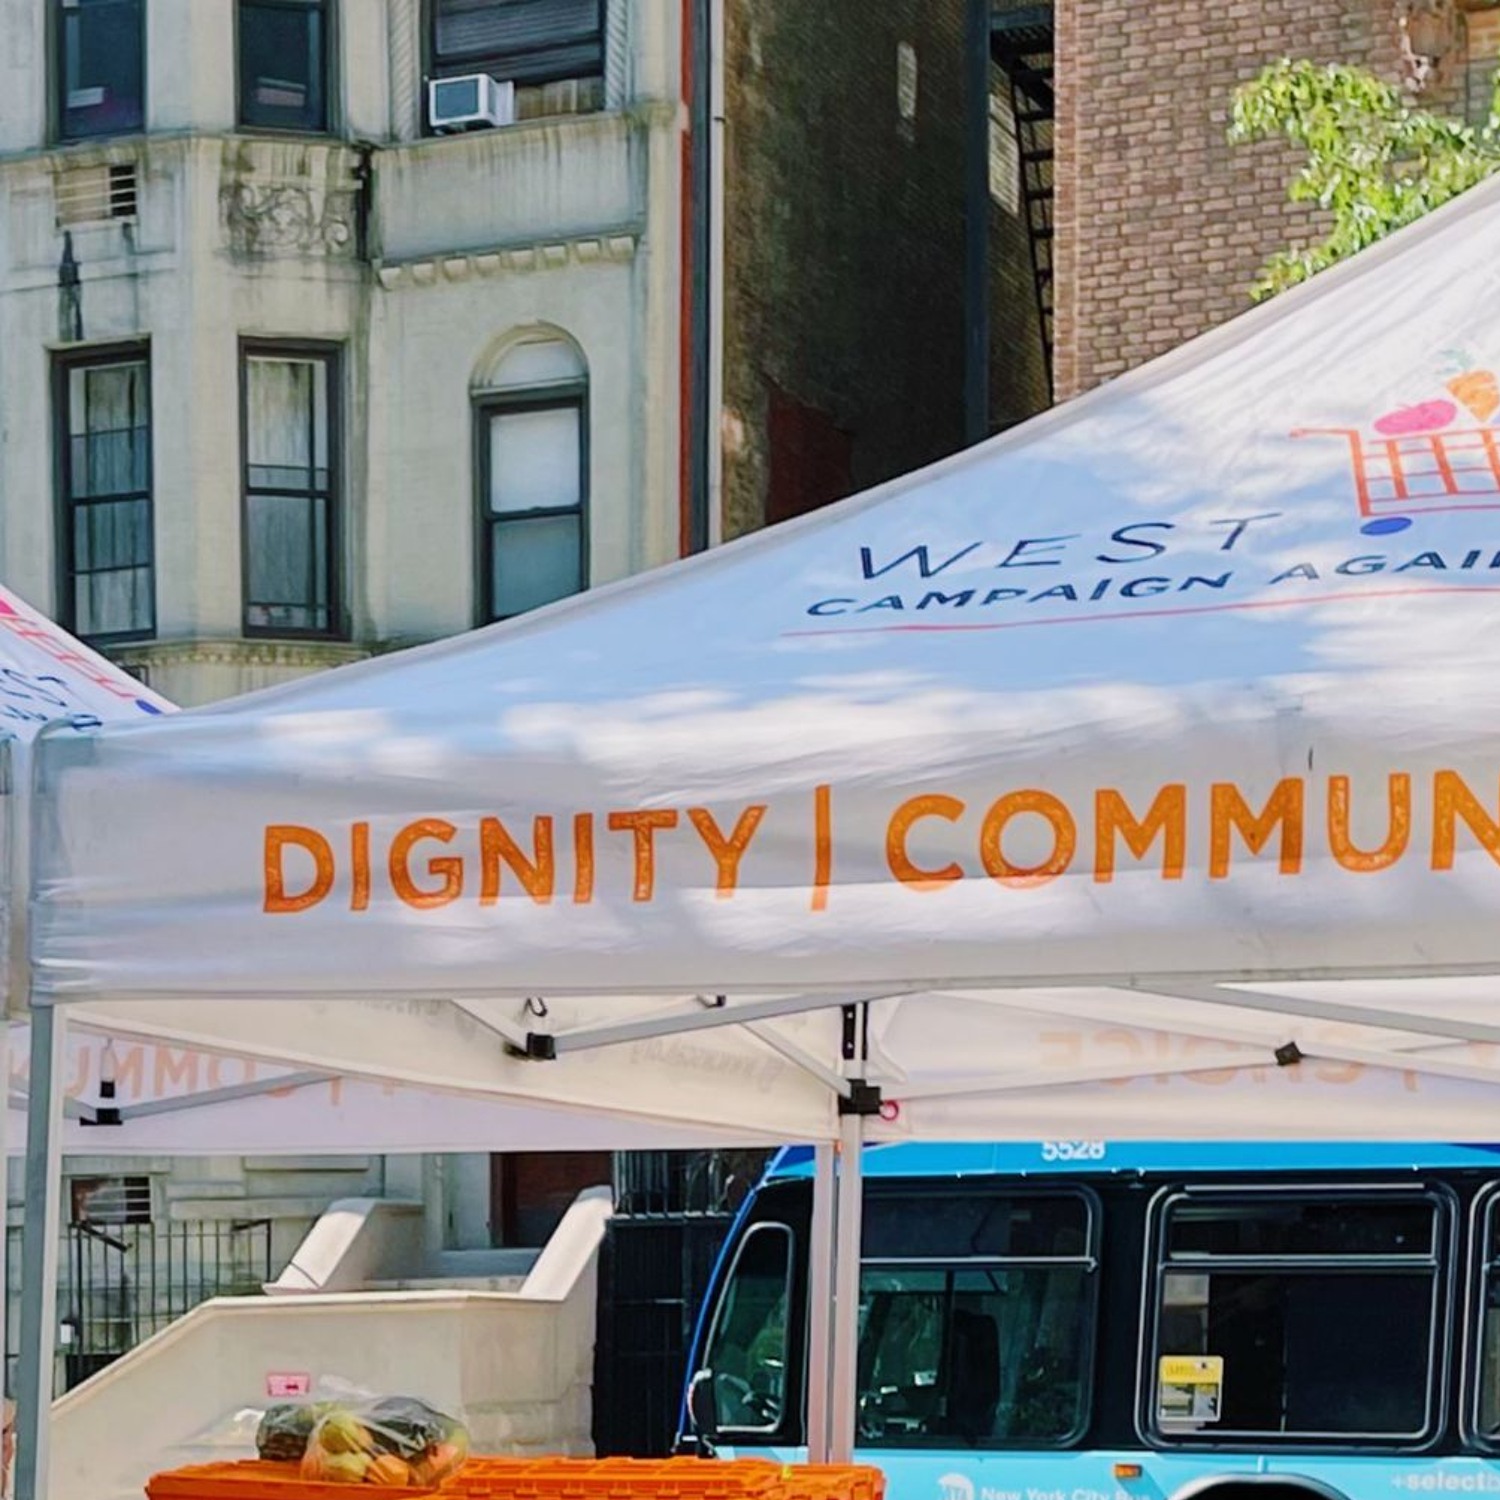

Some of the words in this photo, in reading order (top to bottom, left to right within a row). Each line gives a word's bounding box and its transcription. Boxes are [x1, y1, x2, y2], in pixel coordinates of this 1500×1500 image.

[859, 511, 1283, 581] WEST
[805, 570, 1234, 617] CAMPAIGN
[262, 804, 768, 914] DIGNITY
